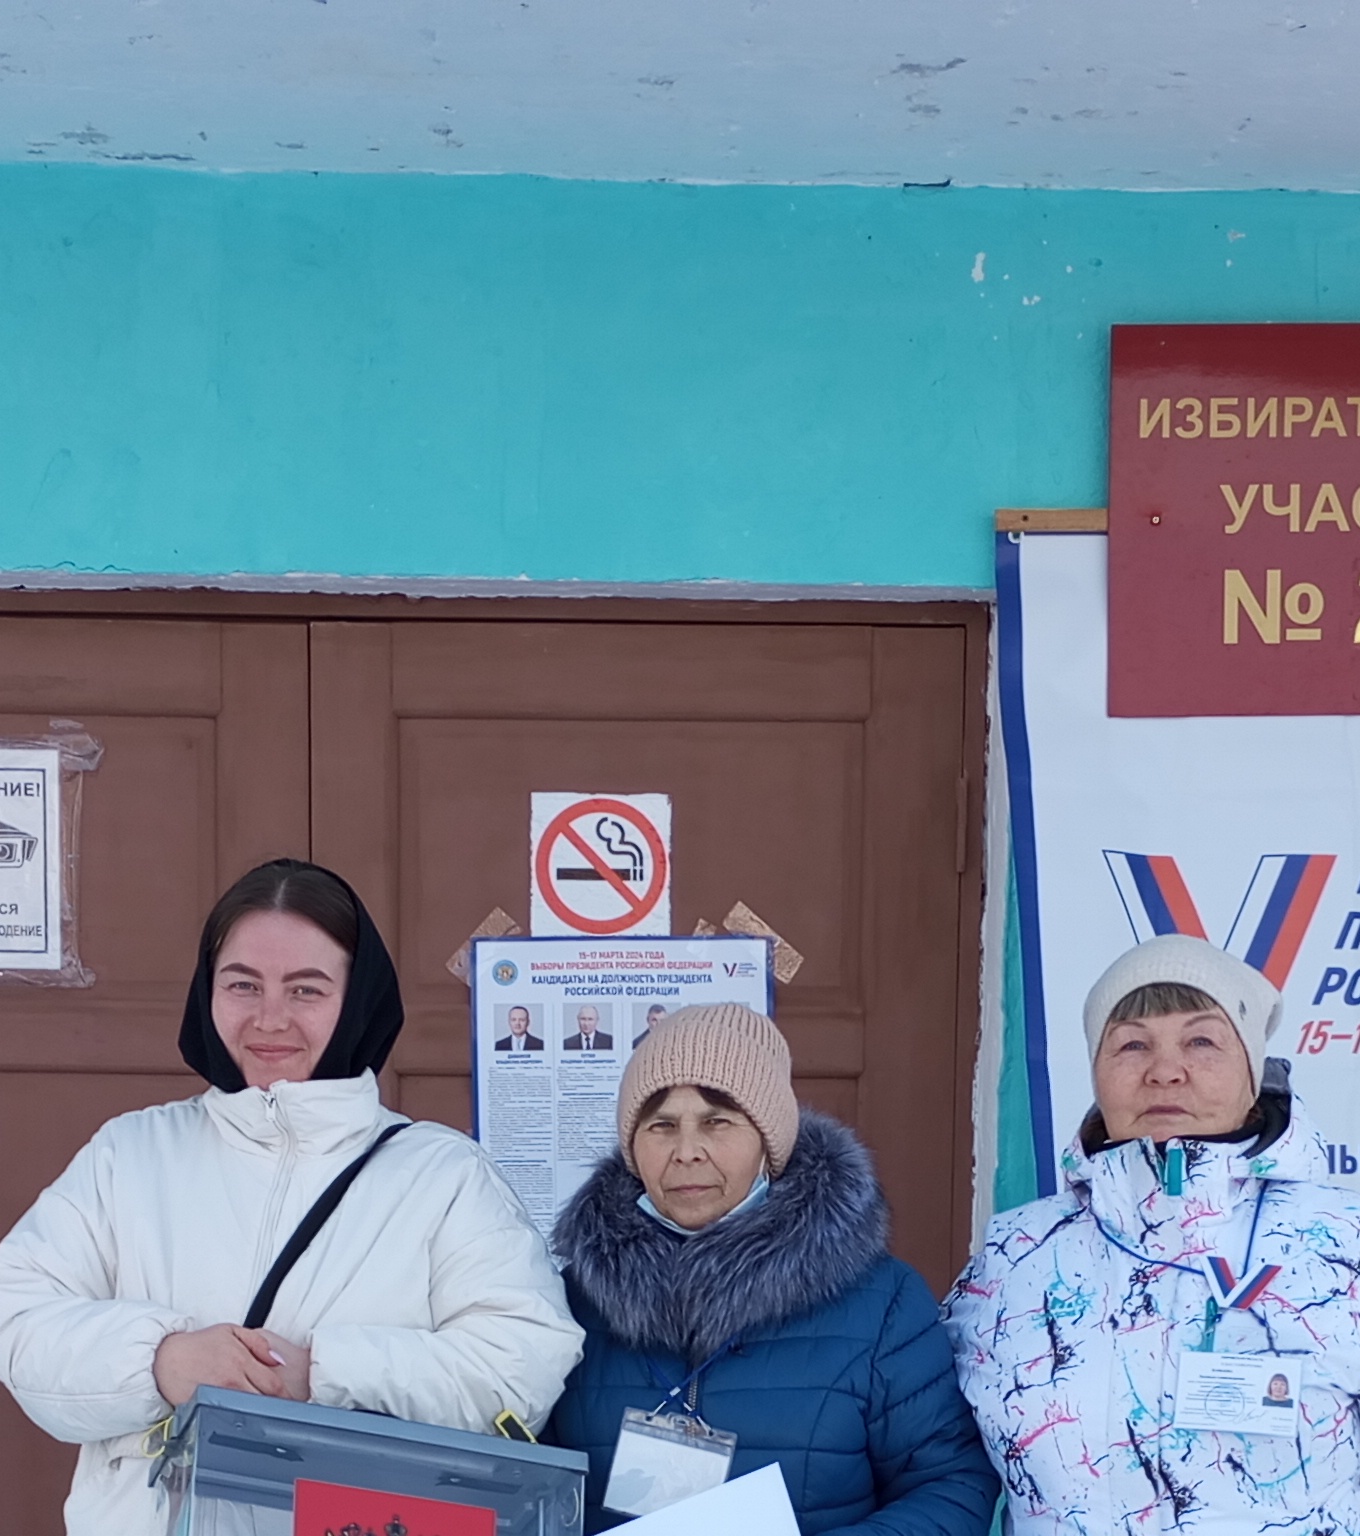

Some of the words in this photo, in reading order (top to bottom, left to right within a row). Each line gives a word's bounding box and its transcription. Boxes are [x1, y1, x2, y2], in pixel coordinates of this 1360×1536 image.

[1223, 567, 1325, 646] №
[599, 951, 625, 960] МАРТА
[645, 951, 665, 960] ГОДА
[530, 962, 565, 971] ВЫБОРЫ
[565, 961, 614, 971] ПРЕЗИДЕНТА
[531, 974, 586, 985] КАНДИДАТЫ
[587, 974, 600, 984] НА
[600, 974, 656, 985] ДОЛЖНОСТЬ
[657, 974, 713, 984] ПРЕЗИДЕНТА
[564, 985, 624, 996] РОССИЙСКОЙ
[625, 986, 680, 996] ФЕДЕРАЦИИ
